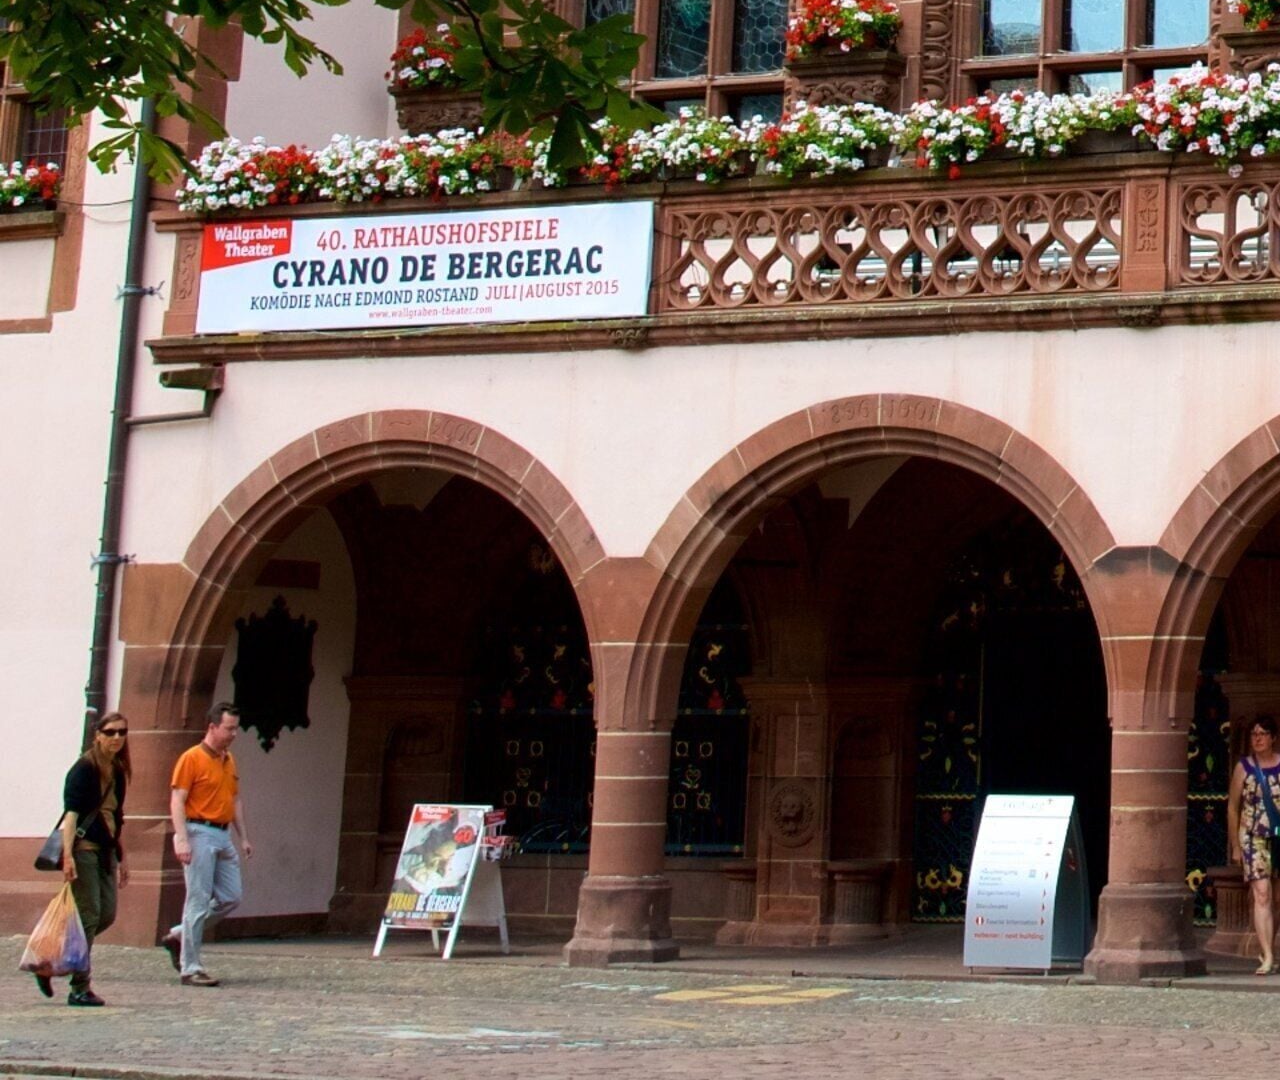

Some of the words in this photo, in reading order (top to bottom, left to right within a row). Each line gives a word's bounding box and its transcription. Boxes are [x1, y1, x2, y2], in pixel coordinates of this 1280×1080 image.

[214, 226, 288, 242] Wallgraben
[316, 230, 347, 252] 40.
[353, 218, 560, 250] RATHAUSHOFSPIELE
[224, 242, 275, 258] Theater
[272, 256, 389, 289] CYRANO
[399, 253, 437, 283] DE
[447, 245, 604, 281] BERGERAC
[249, 291, 312, 311] KOMÖDIE
[314, 292, 352, 309] NACH
[355, 289, 413, 307] EDMOND
[416, 286, 479, 304] ROSTAND
[585, 279, 620, 296] 2015
[367, 305, 493, 320] www.wallgraben-theater.com
